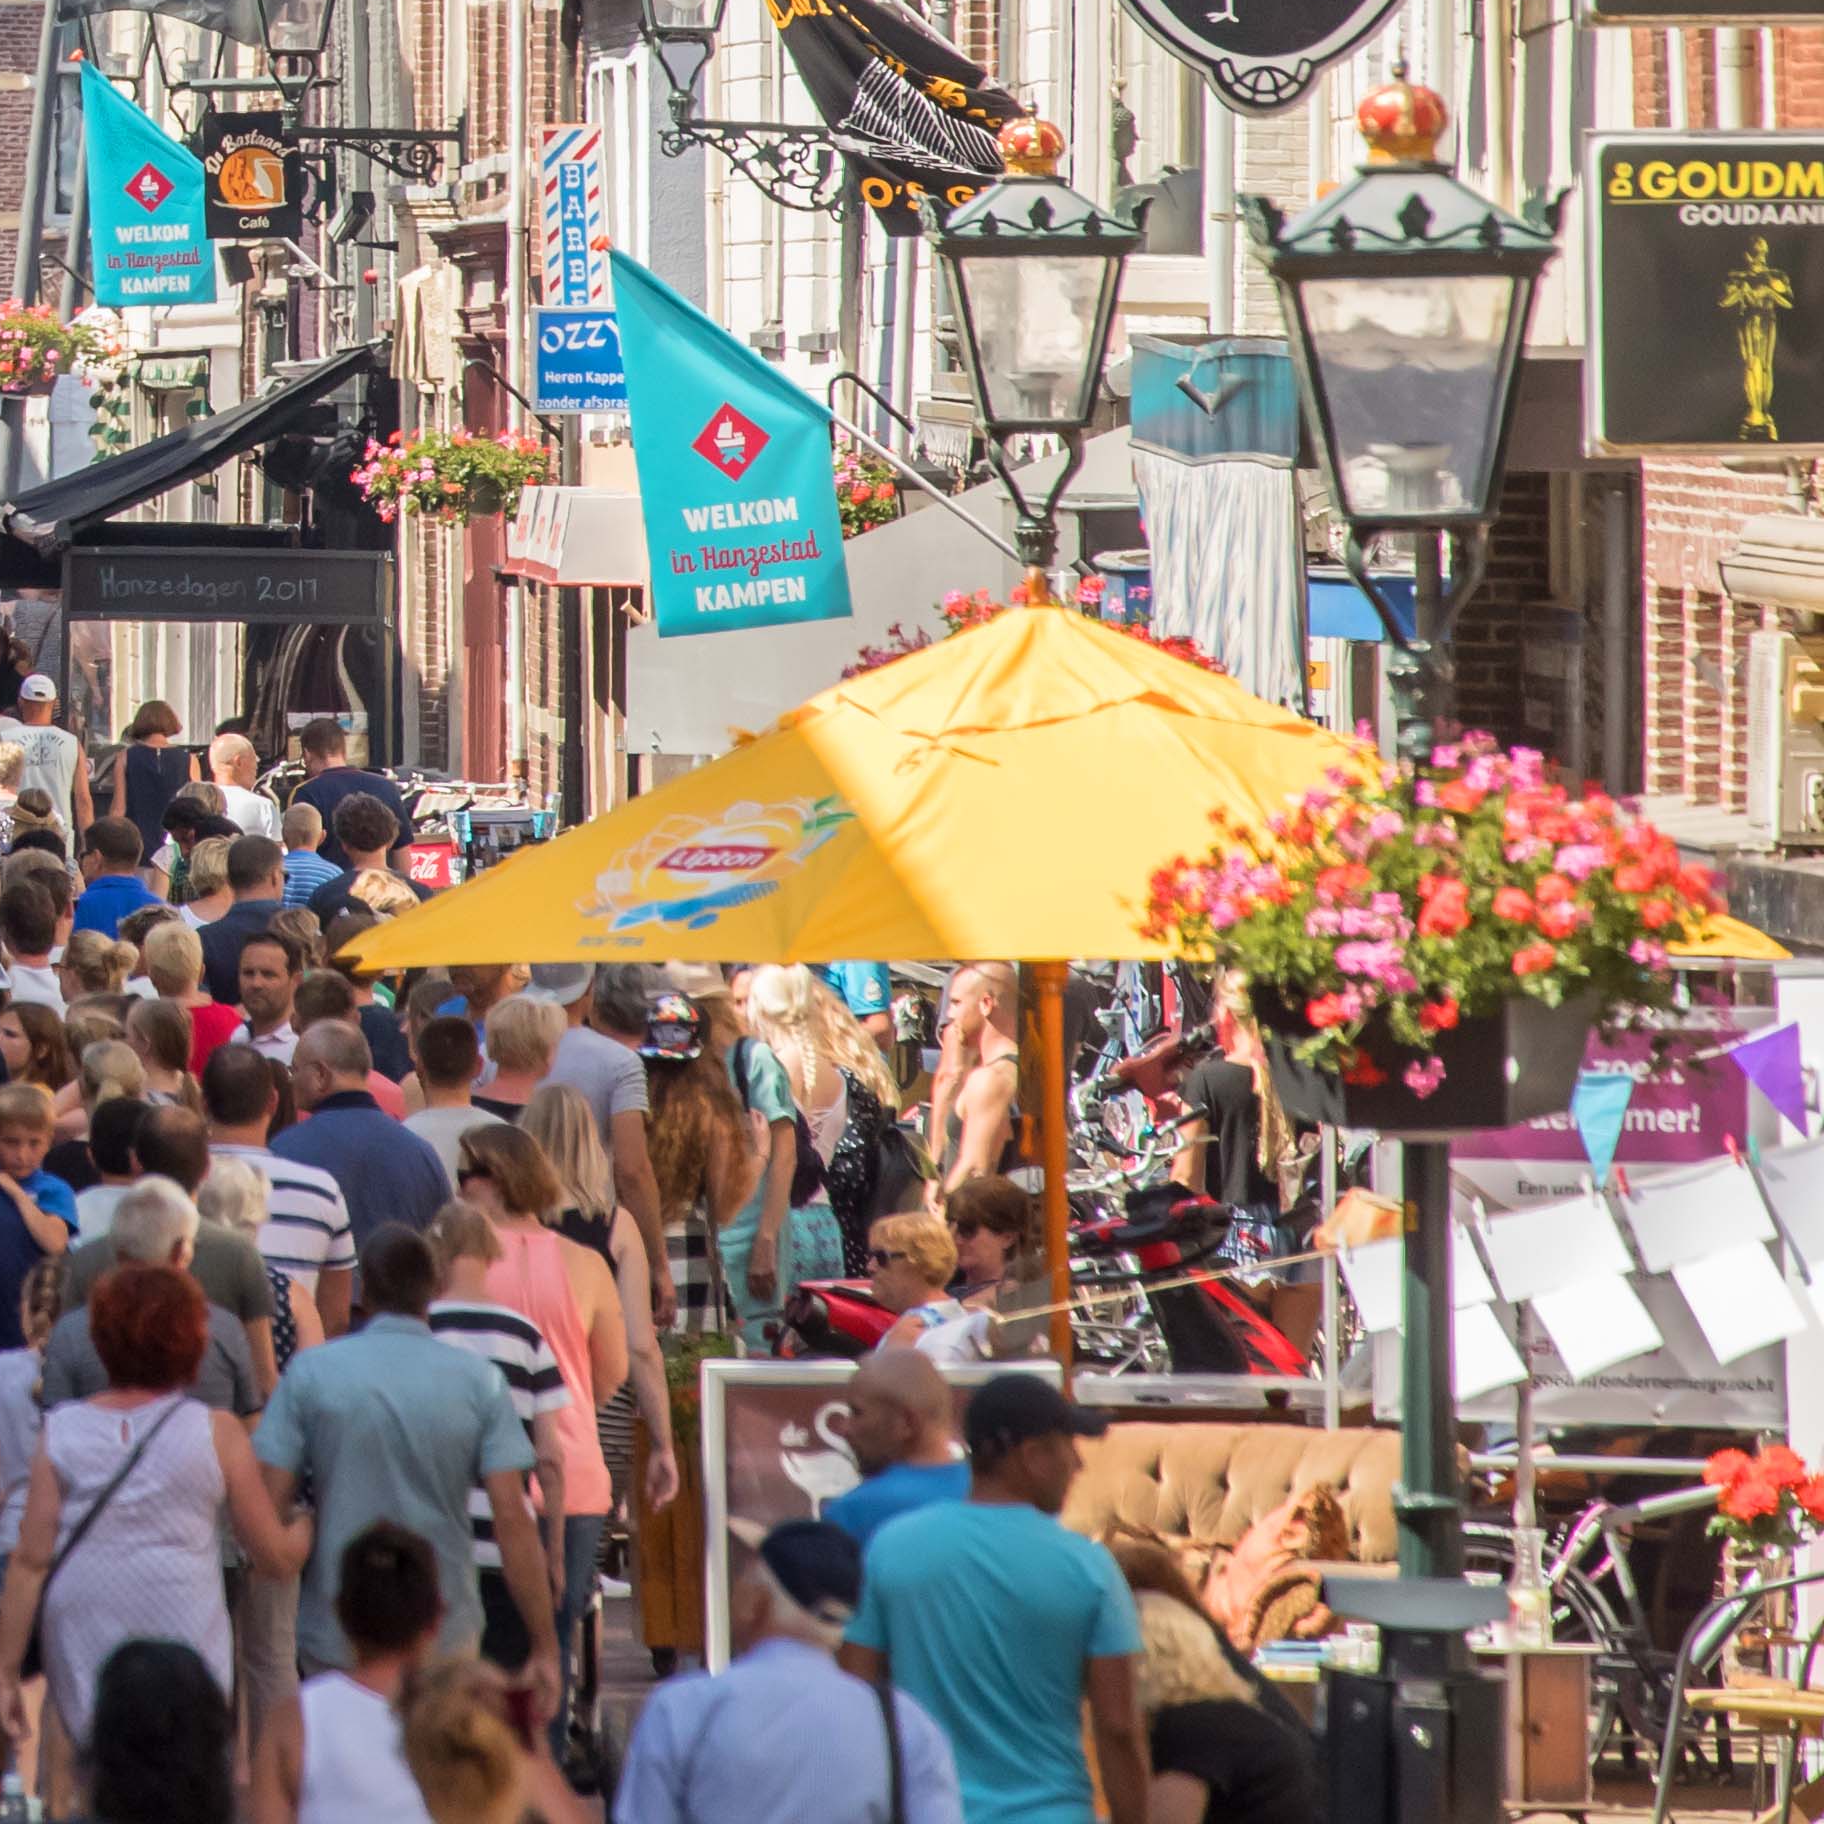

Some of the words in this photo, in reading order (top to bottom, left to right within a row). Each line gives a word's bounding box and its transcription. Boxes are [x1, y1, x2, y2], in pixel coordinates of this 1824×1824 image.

[1679, 204, 1824, 226] GOUDAAN
[115, 223, 190, 245] WELKOM
[120, 275, 191, 295] KAMPEN
[544, 370, 583, 385] Heren
[681, 496, 800, 534] WELKOM
[671, 550, 698, 575] in
[699, 529, 823, 577] Hanzestad
[100, 566, 248, 607] Hanzedagen
[256, 575, 319, 602] 2017
[695, 576, 807, 613] KAMPEN
[668, 847, 764, 871] Lipton
